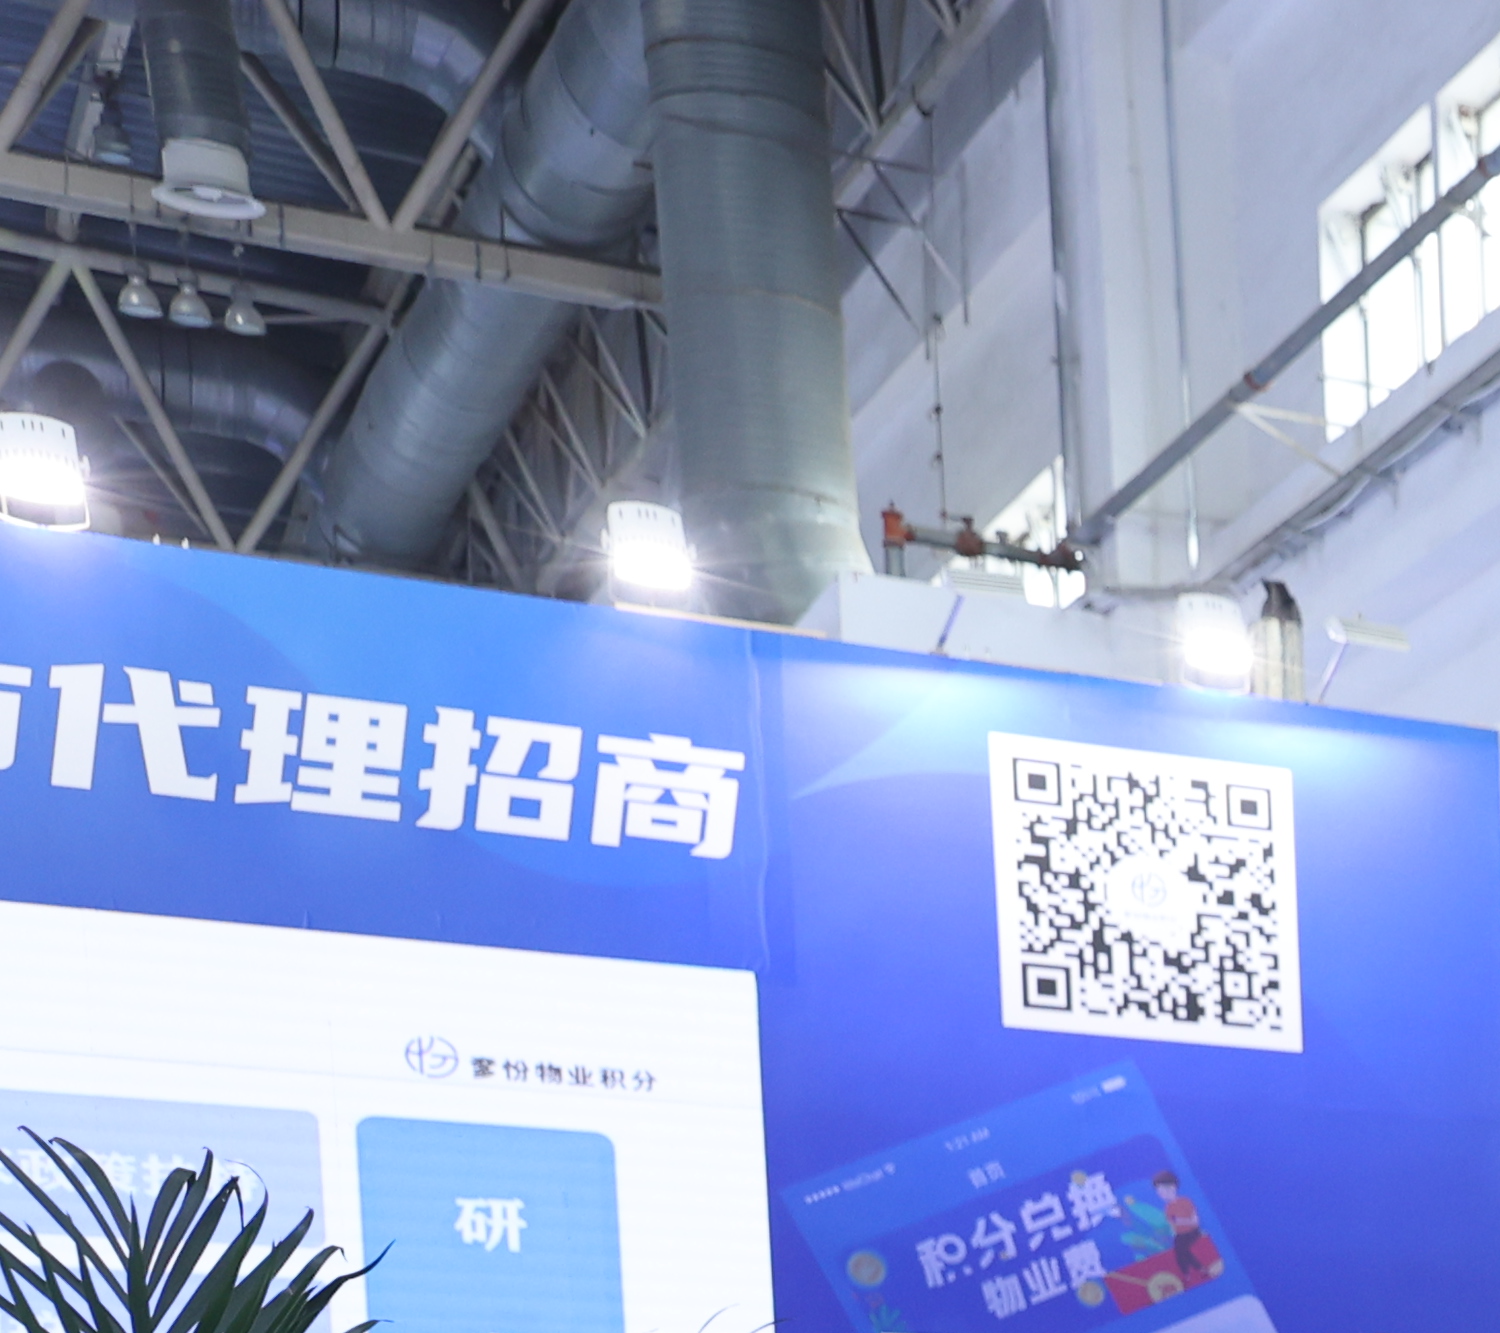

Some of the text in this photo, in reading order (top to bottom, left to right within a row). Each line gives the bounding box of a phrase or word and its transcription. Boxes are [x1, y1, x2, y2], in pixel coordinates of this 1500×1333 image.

[916, 1171, 1121, 1290] 积分兑换
[981, 1239, 1108, 1320] 物业费
